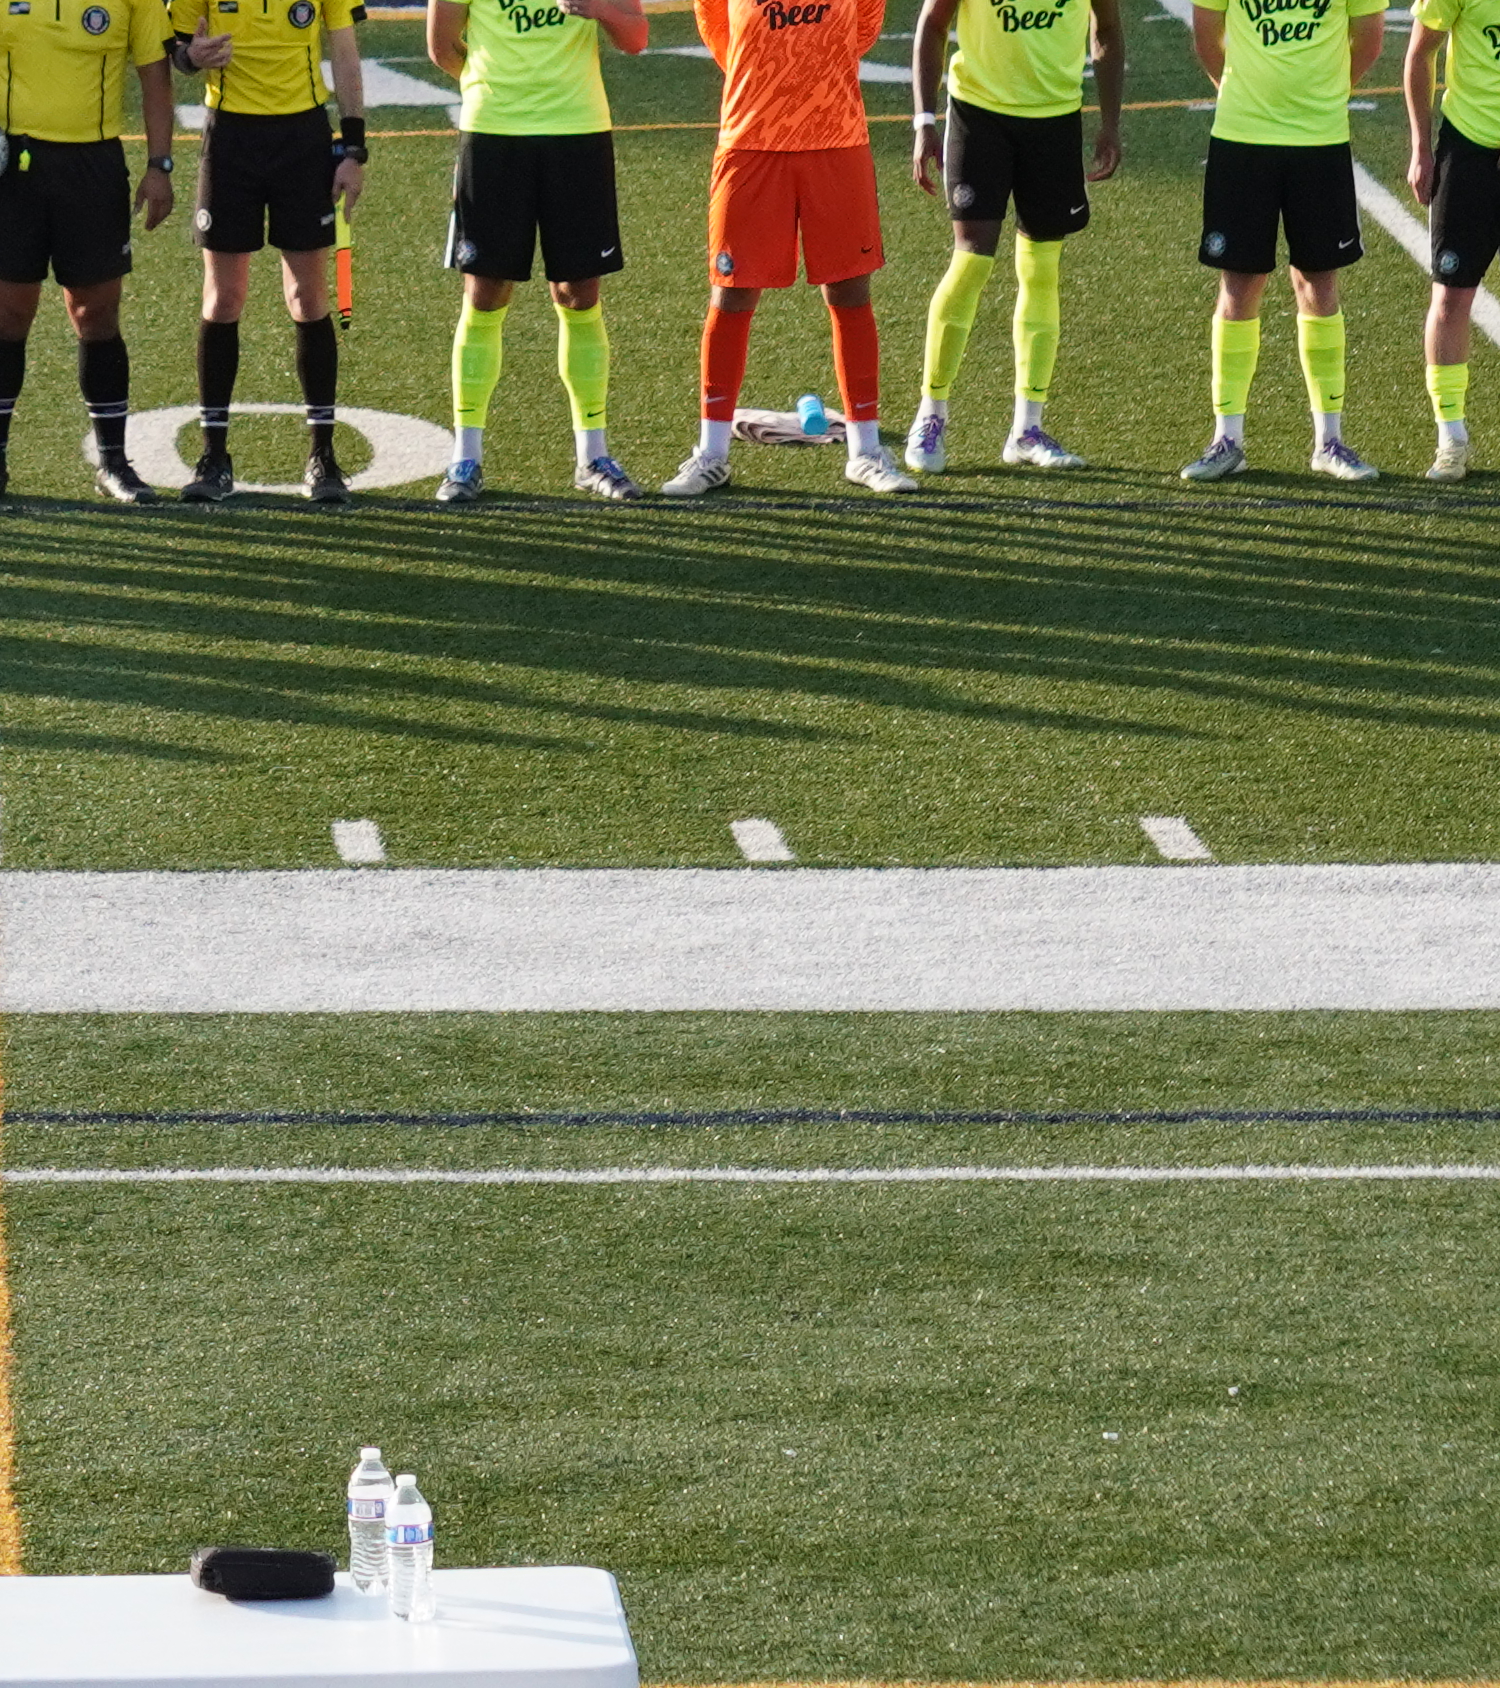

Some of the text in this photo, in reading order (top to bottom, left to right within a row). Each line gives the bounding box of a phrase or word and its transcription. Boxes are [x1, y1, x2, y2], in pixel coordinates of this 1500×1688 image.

[762, 0, 832, 31] Beer
[997, 5, 1064, 34] Beer
[1255, 18, 1322, 48] Beer
